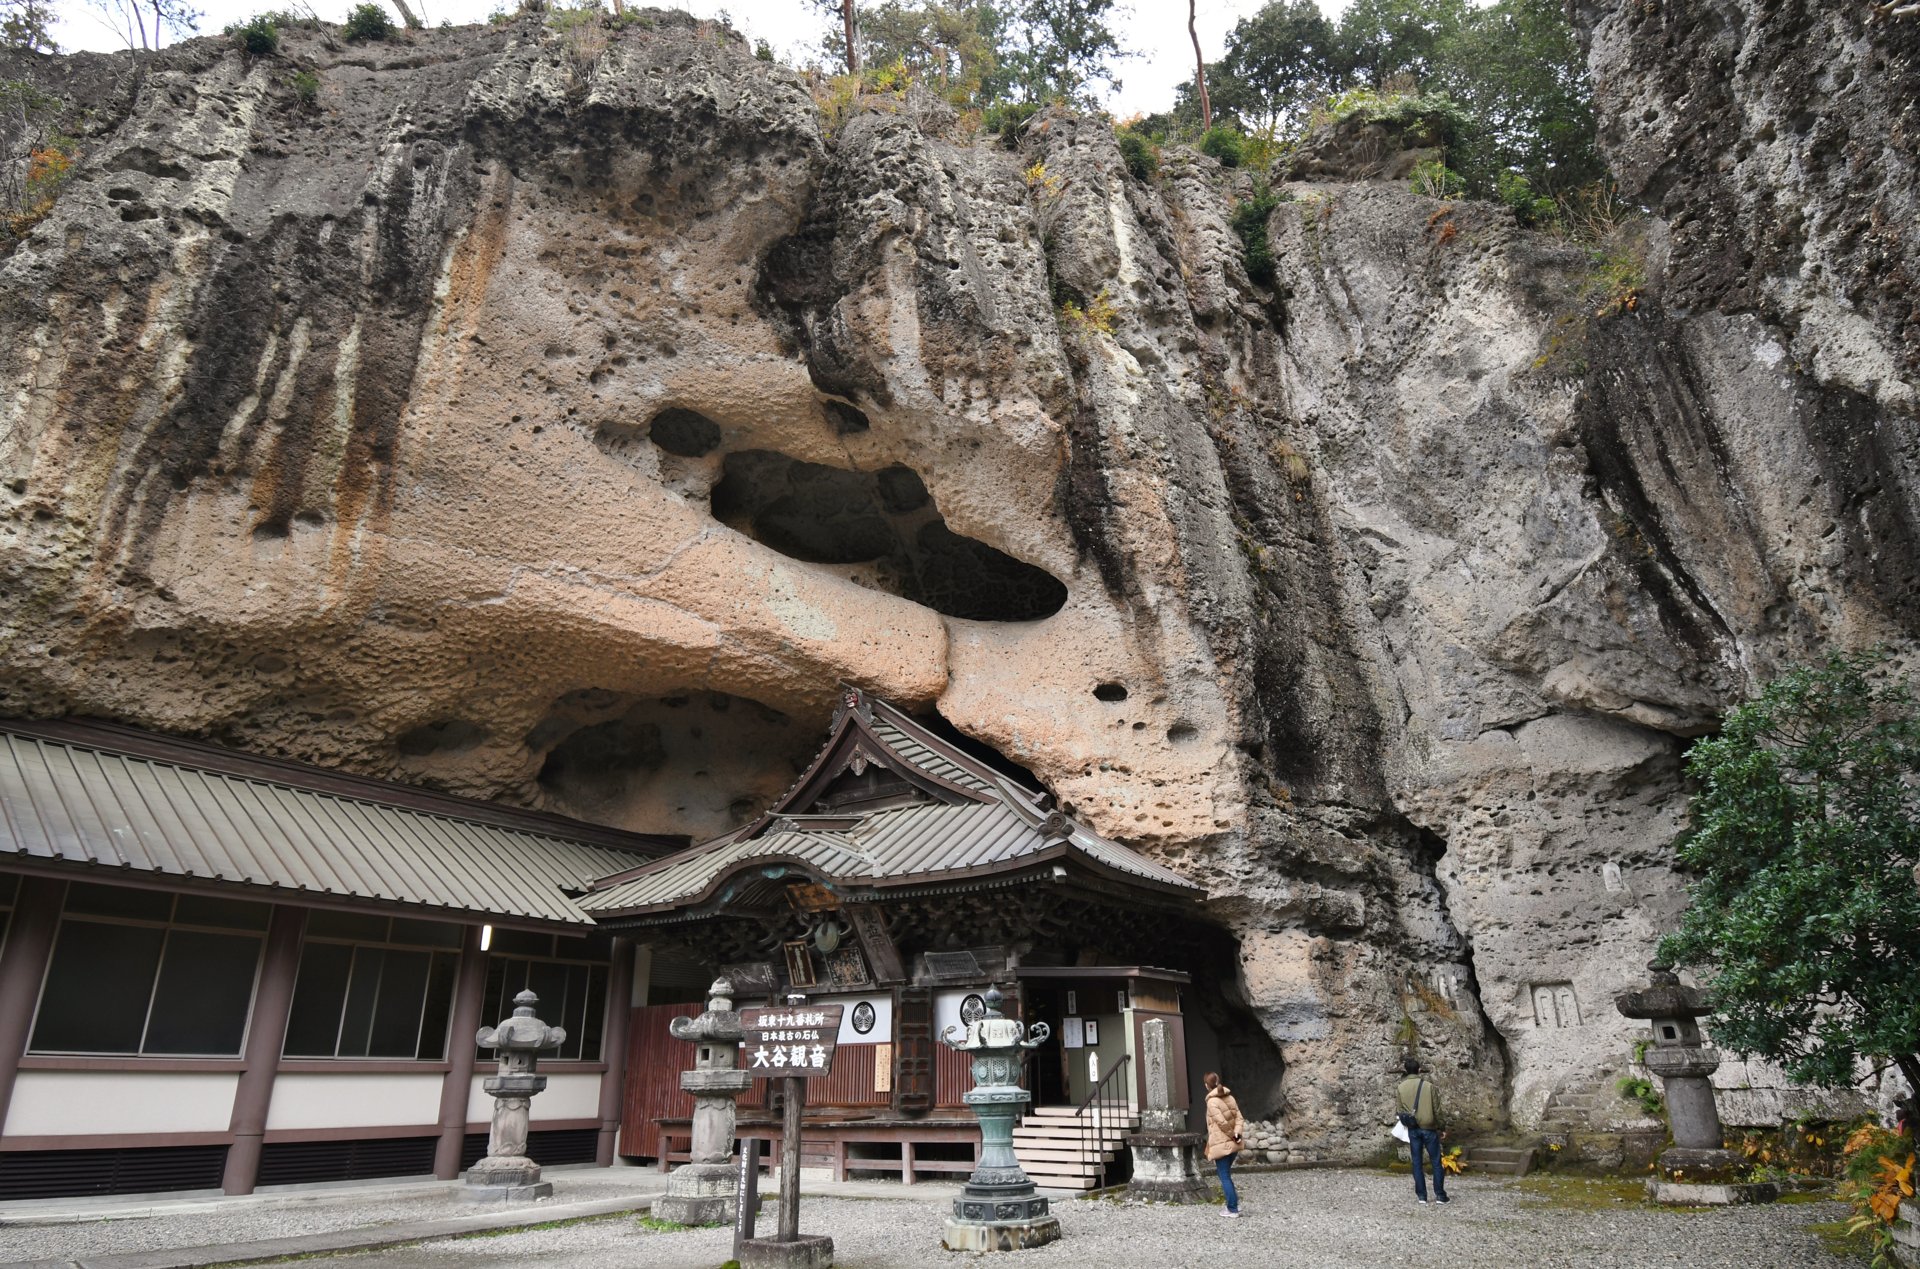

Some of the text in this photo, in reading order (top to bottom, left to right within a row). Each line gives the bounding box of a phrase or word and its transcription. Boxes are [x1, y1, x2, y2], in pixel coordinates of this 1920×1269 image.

[758, 1012, 824, 1027] 坂東十九番札所
[761, 1030, 819, 1041] 日本最古の石仏
[752, 1044, 826, 1068] 大谷観音
